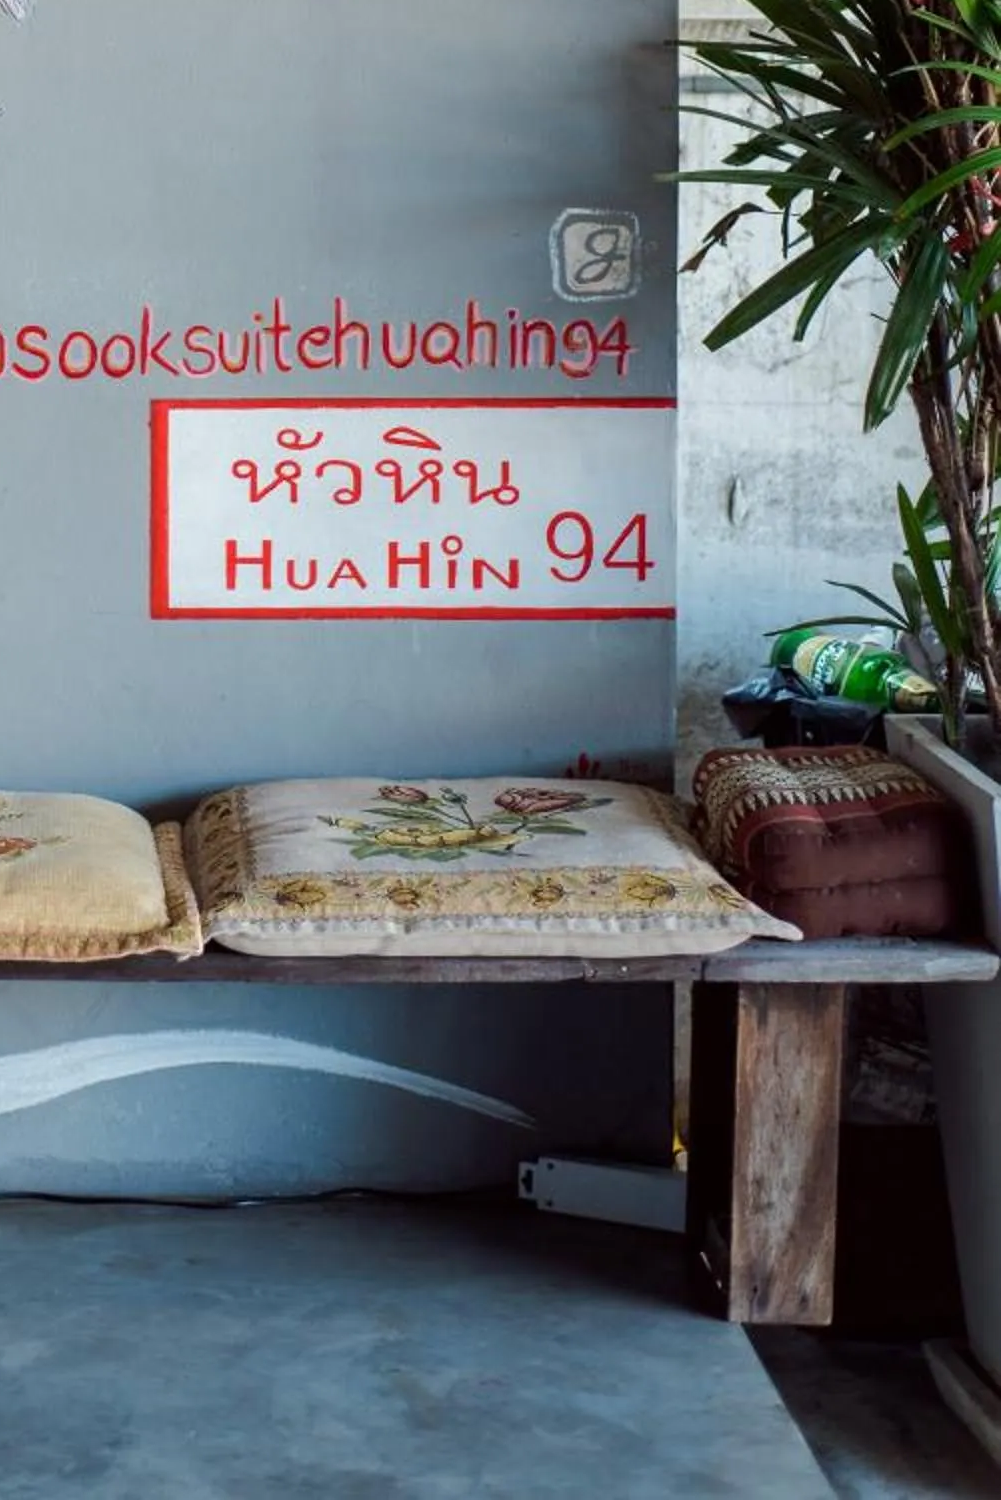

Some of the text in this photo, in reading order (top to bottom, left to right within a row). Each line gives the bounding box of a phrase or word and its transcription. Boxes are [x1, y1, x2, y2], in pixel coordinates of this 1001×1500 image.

[231, 426, 520, 505] หัวหิน
[546, 512, 655, 583] 94
